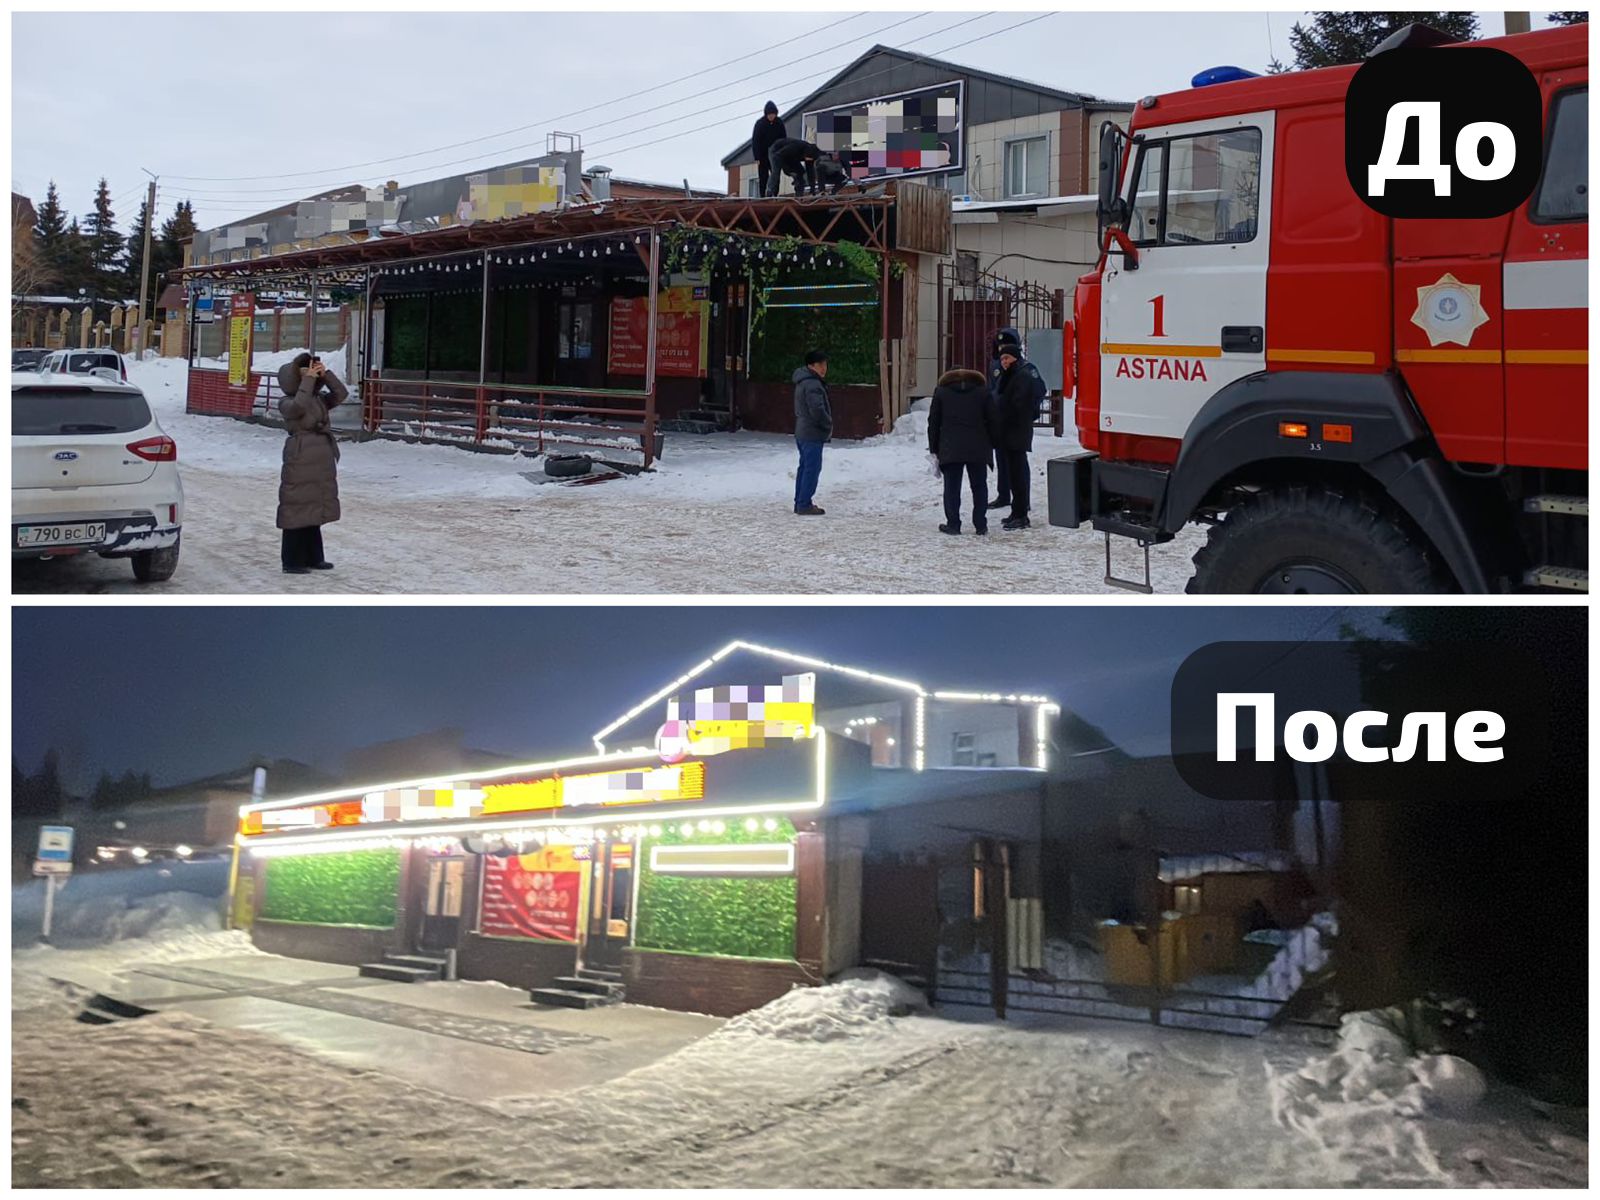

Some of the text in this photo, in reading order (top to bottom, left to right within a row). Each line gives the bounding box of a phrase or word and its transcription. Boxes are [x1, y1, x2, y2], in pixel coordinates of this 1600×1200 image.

[1147, 294, 1168, 337] 1
[1115, 357, 1207, 382] ASTANA
[33, 524, 104, 541] 790 BC 01
